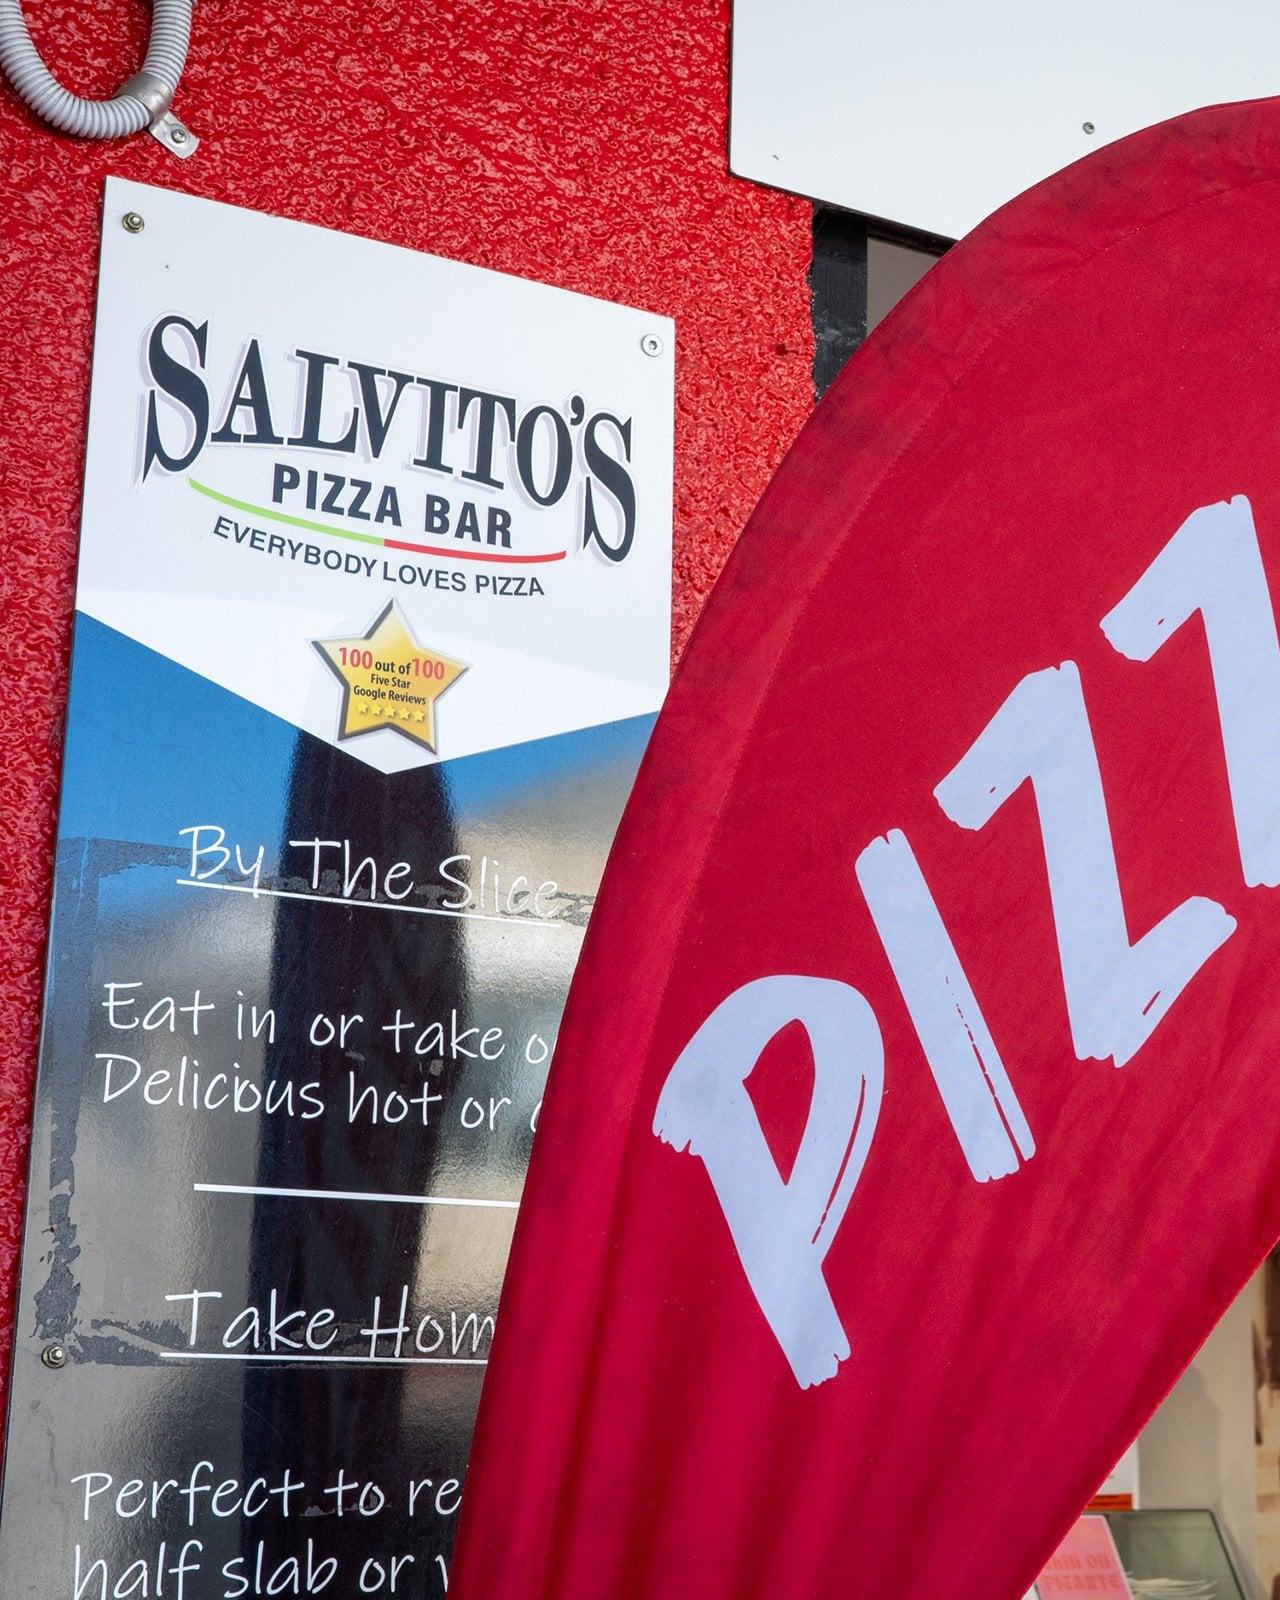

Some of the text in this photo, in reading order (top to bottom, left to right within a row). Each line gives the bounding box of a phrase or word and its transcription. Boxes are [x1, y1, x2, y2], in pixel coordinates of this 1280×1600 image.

[141, 314, 637, 564] SALVITO'S
[271, 463, 513, 549] PIZZA BAR
[212, 516, 546, 597] EVERYBODY LOVES PIZZA
[337, 646, 446, 681] 100 out of 100
[352, 685, 427, 706] Google Reviews
[370, 673, 411, 690] Five Star
[179, 826, 562, 920] By The Slice
[102, 982, 214, 1031] Eat
[236, 991, 276, 1044] in
[310, 1009, 363, 1048] or
[383, 1008, 504, 1063] take
[95, 1053, 326, 1119] Delicious
[348, 1070, 443, 1126] hot
[460, 1097, 512, 1133] or
[165, 1289, 338, 1350] Take
[70, 1461, 305, 1527] Perfect
[324, 1469, 385, 1515] to
[74, 1540, 204, 1600] half
[229, 1539, 336, 1593] slab
[359, 1554, 415, 1594] or
